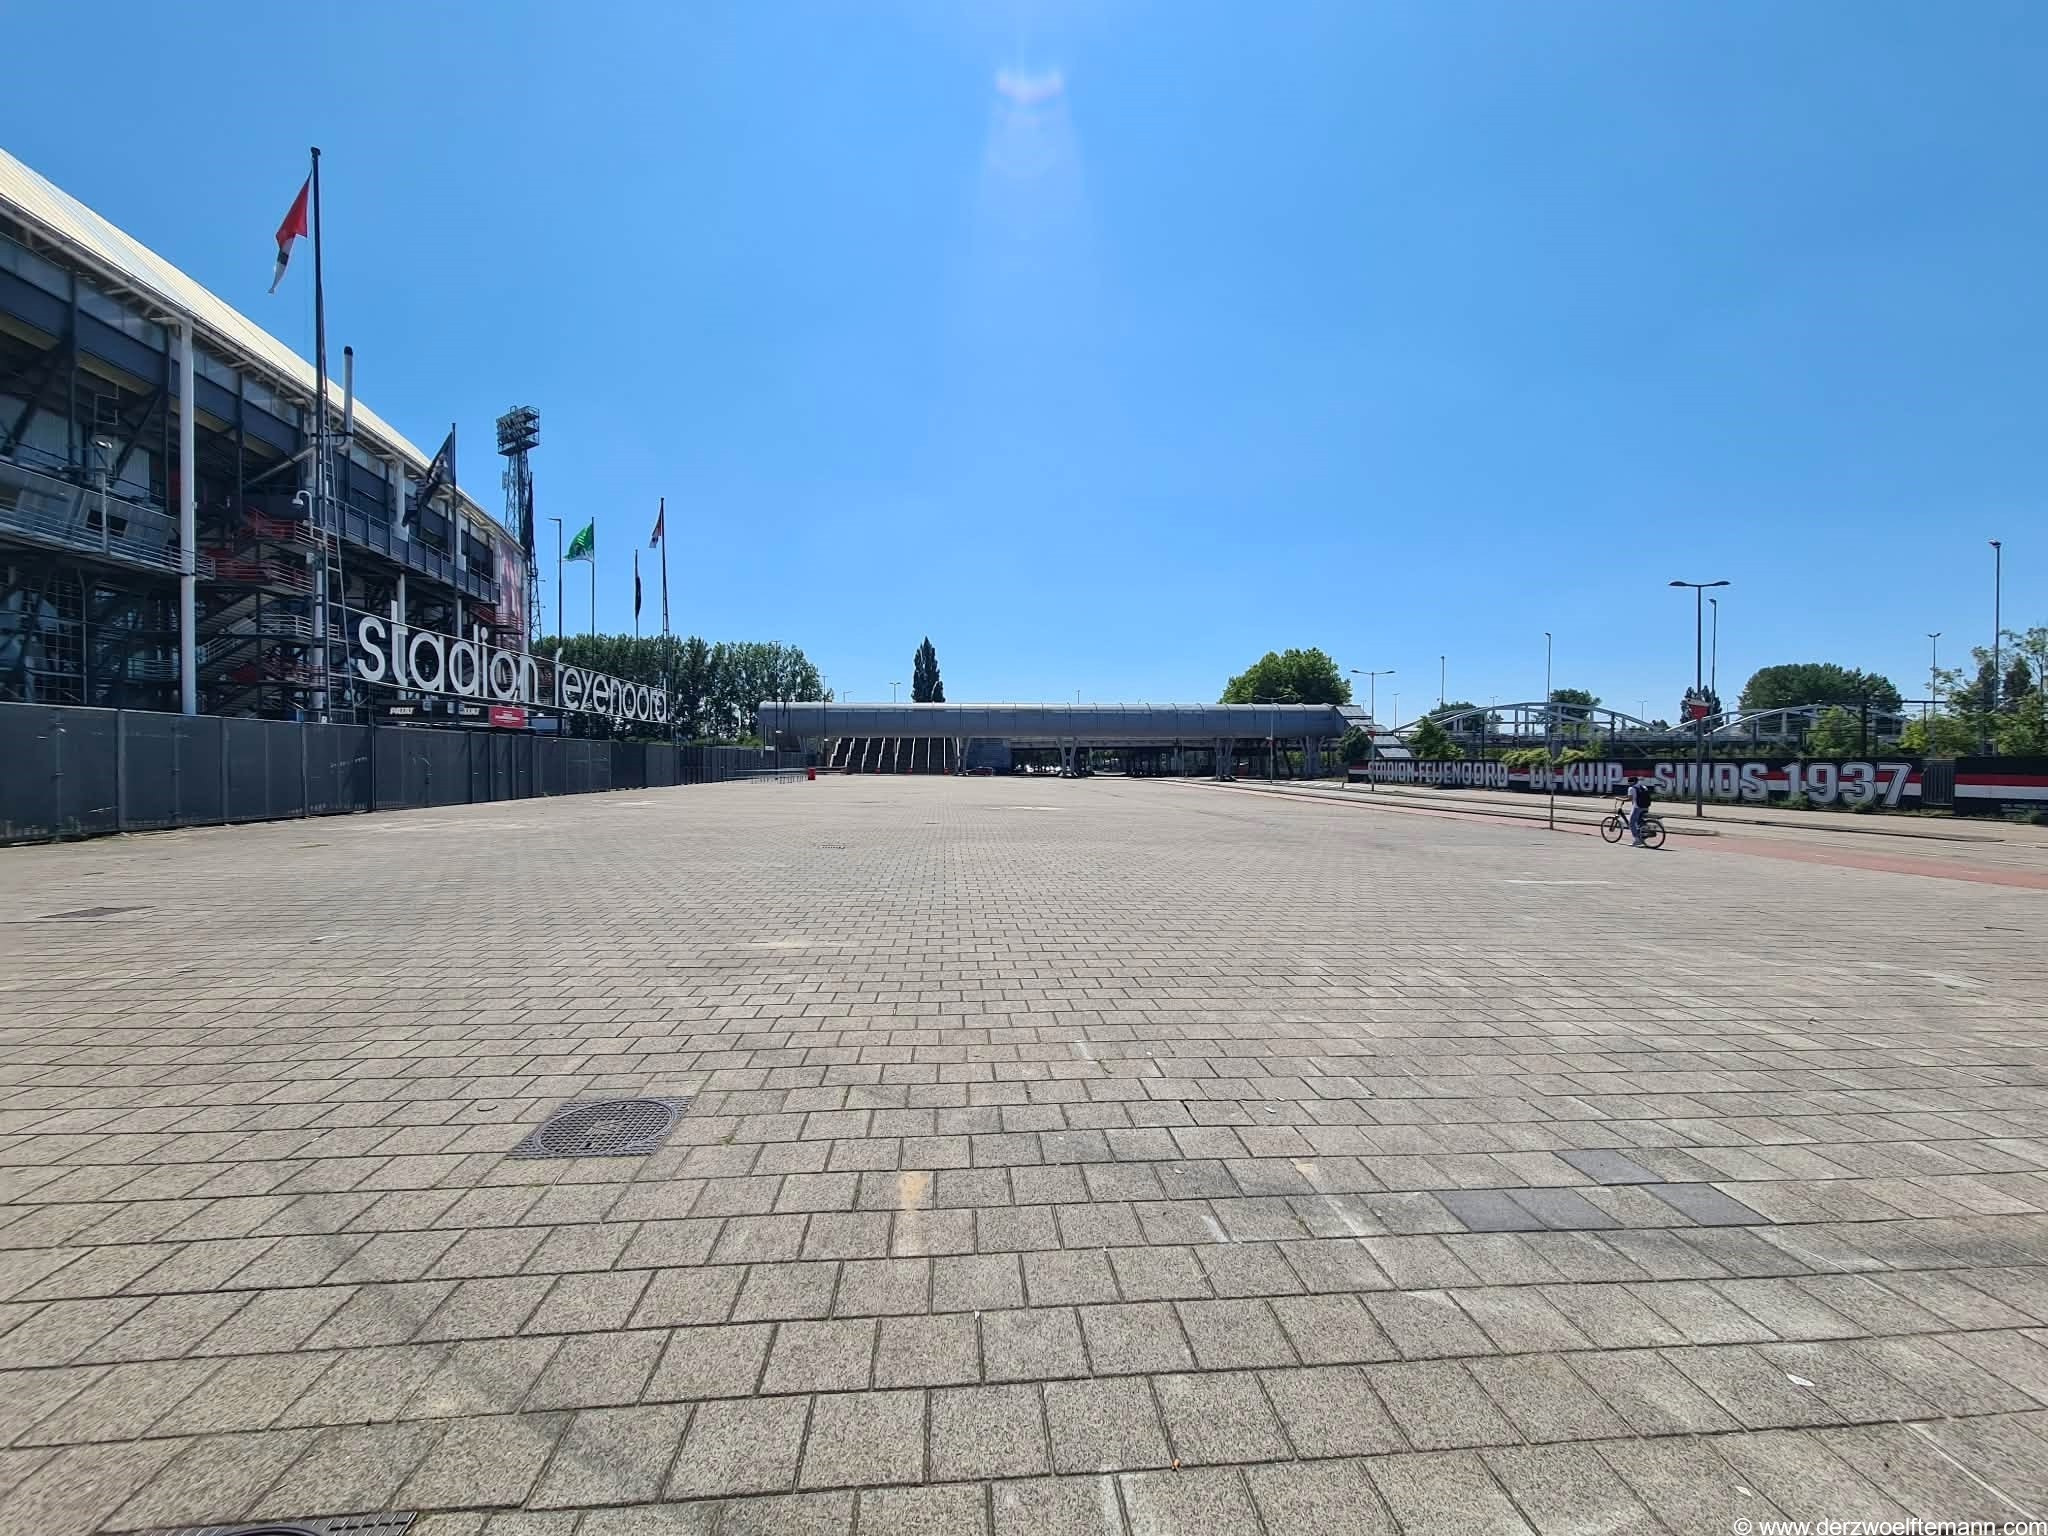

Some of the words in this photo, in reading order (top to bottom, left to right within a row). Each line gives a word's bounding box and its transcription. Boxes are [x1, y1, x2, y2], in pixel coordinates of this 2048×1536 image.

[358, 600, 538, 705] stadion
[554, 647, 668, 722] feyenoord
[1563, 762, 1623, 793] KUIP
[1781, 761, 1912, 807] 1937
